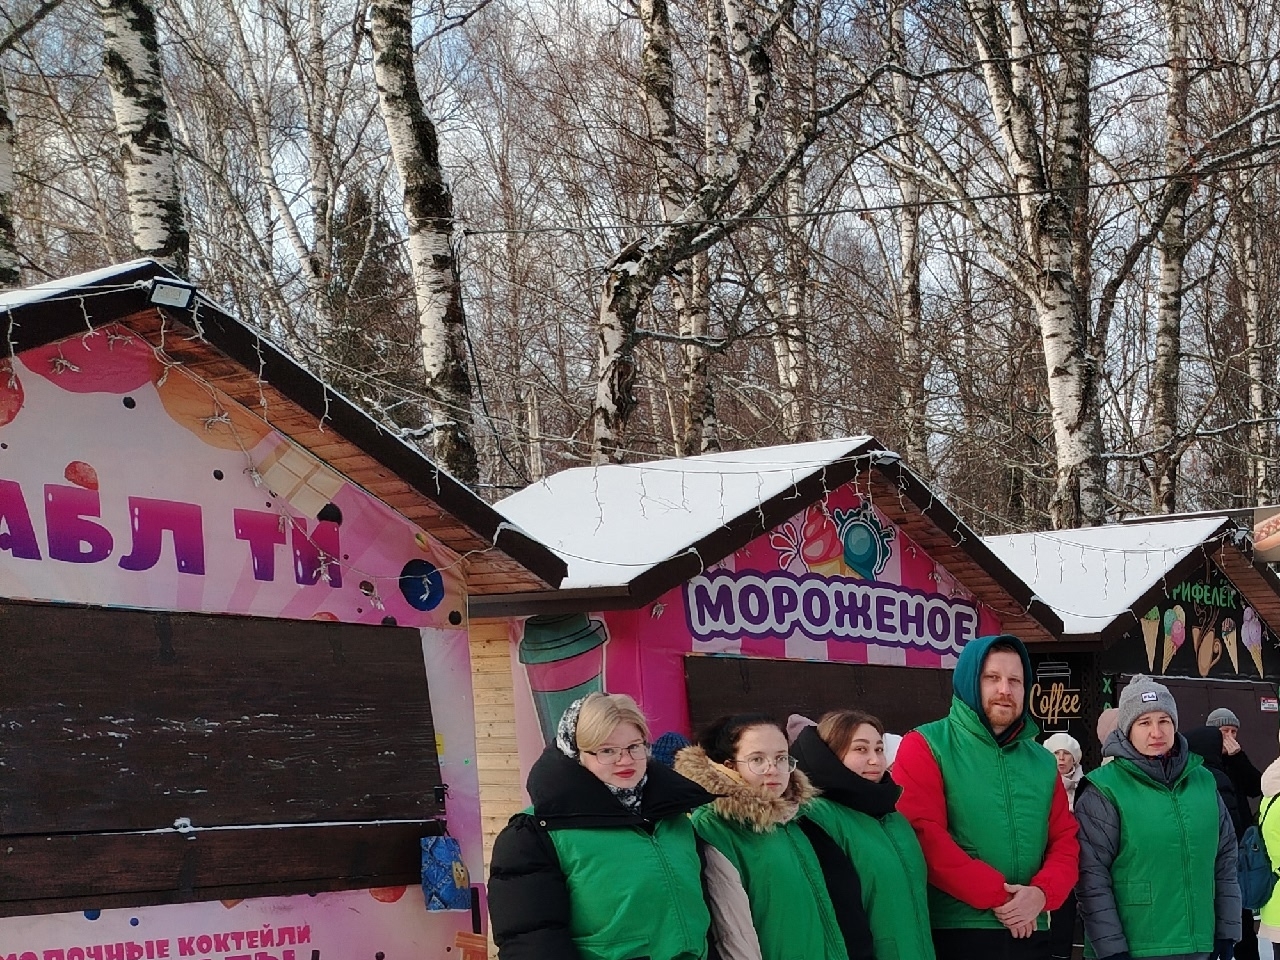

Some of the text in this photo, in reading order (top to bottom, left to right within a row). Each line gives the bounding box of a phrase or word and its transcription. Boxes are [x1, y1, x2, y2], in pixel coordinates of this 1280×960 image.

[233, 508, 342, 588] ТИ
[694, 584, 974, 647] МОРОЖЕНОЕ
[1029, 682, 1082, 725] Coffee
[177, 923, 312, 957] КОКТЕЙЛИ
